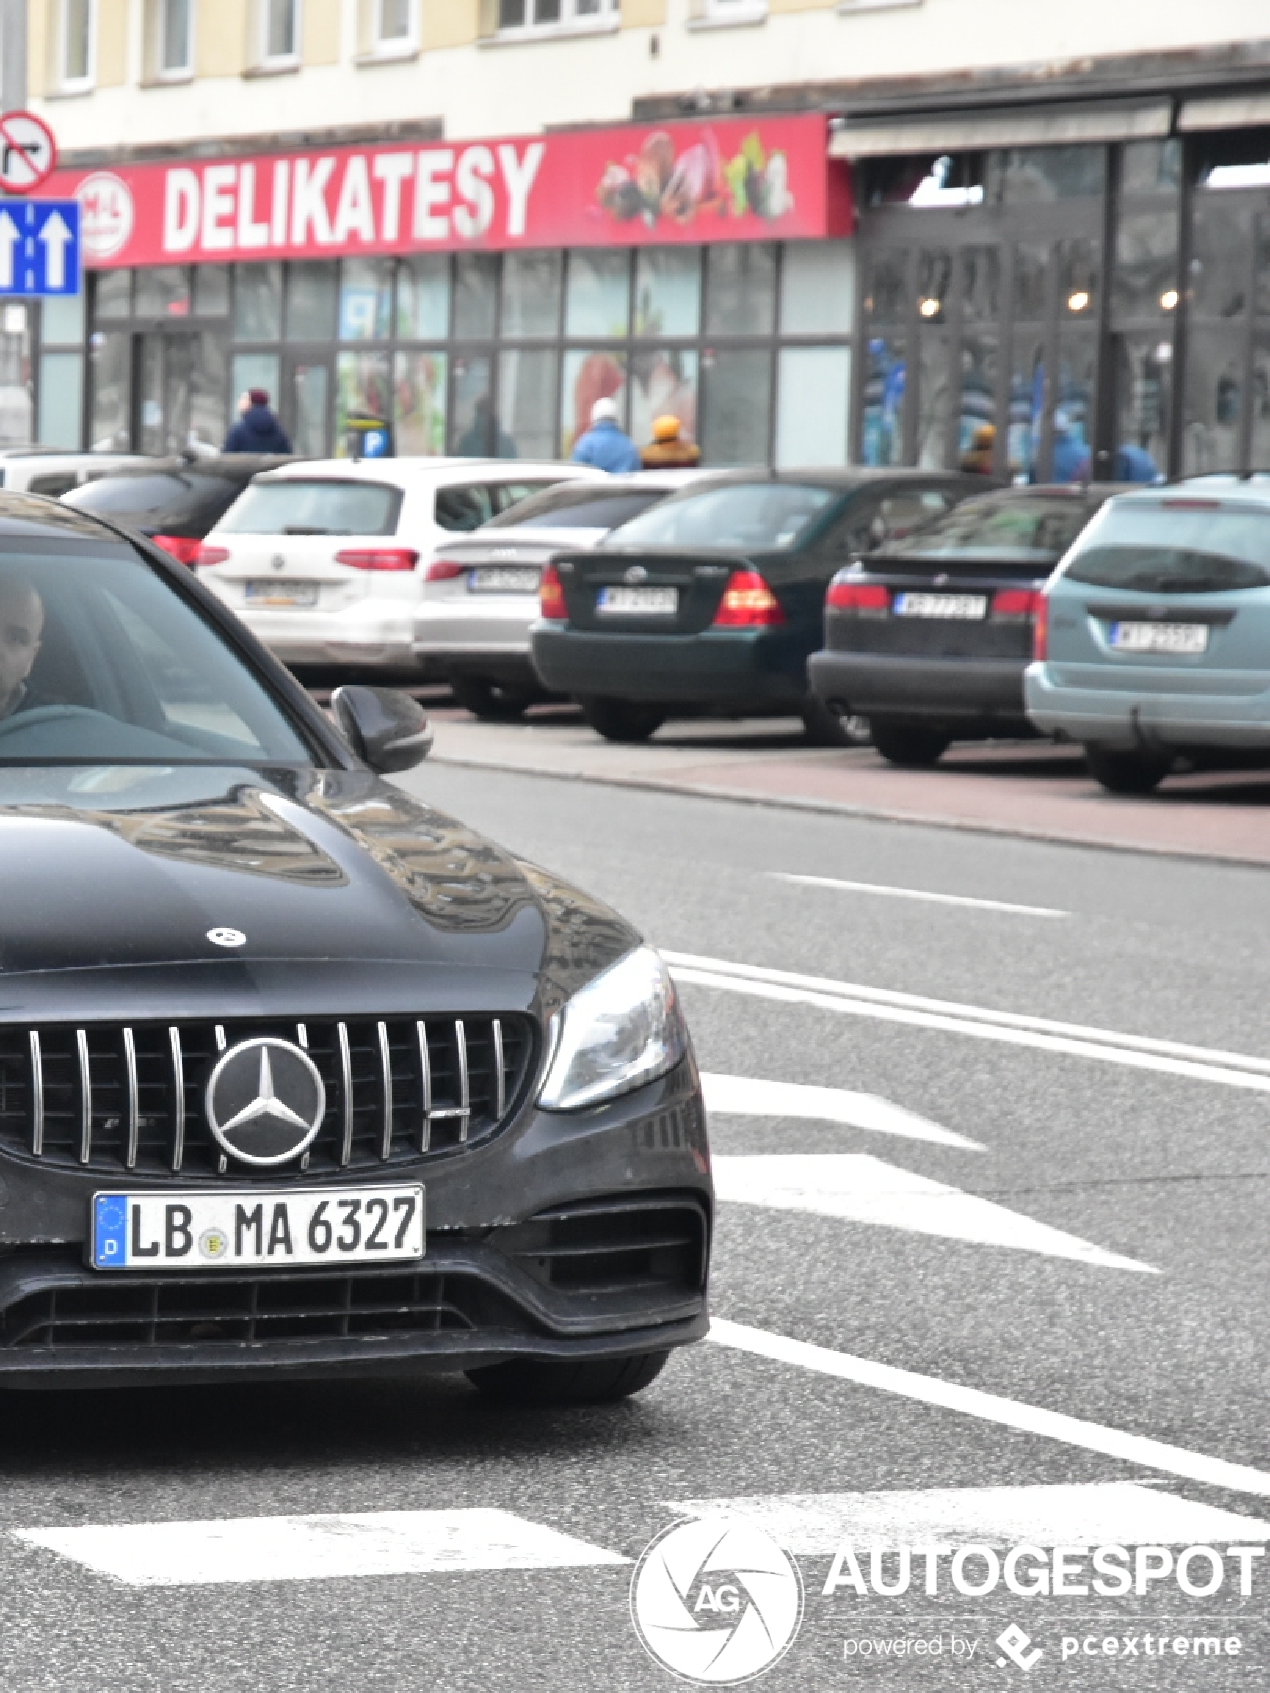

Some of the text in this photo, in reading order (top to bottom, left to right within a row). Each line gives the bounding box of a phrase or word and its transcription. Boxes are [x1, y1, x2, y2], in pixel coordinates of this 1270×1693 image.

[163, 142, 546, 253] DELIKATESY
[364, 430, 383, 457] P
[104, 1239, 117, 1255] D
[132, 1196, 416, 1257] LB MA 6327
